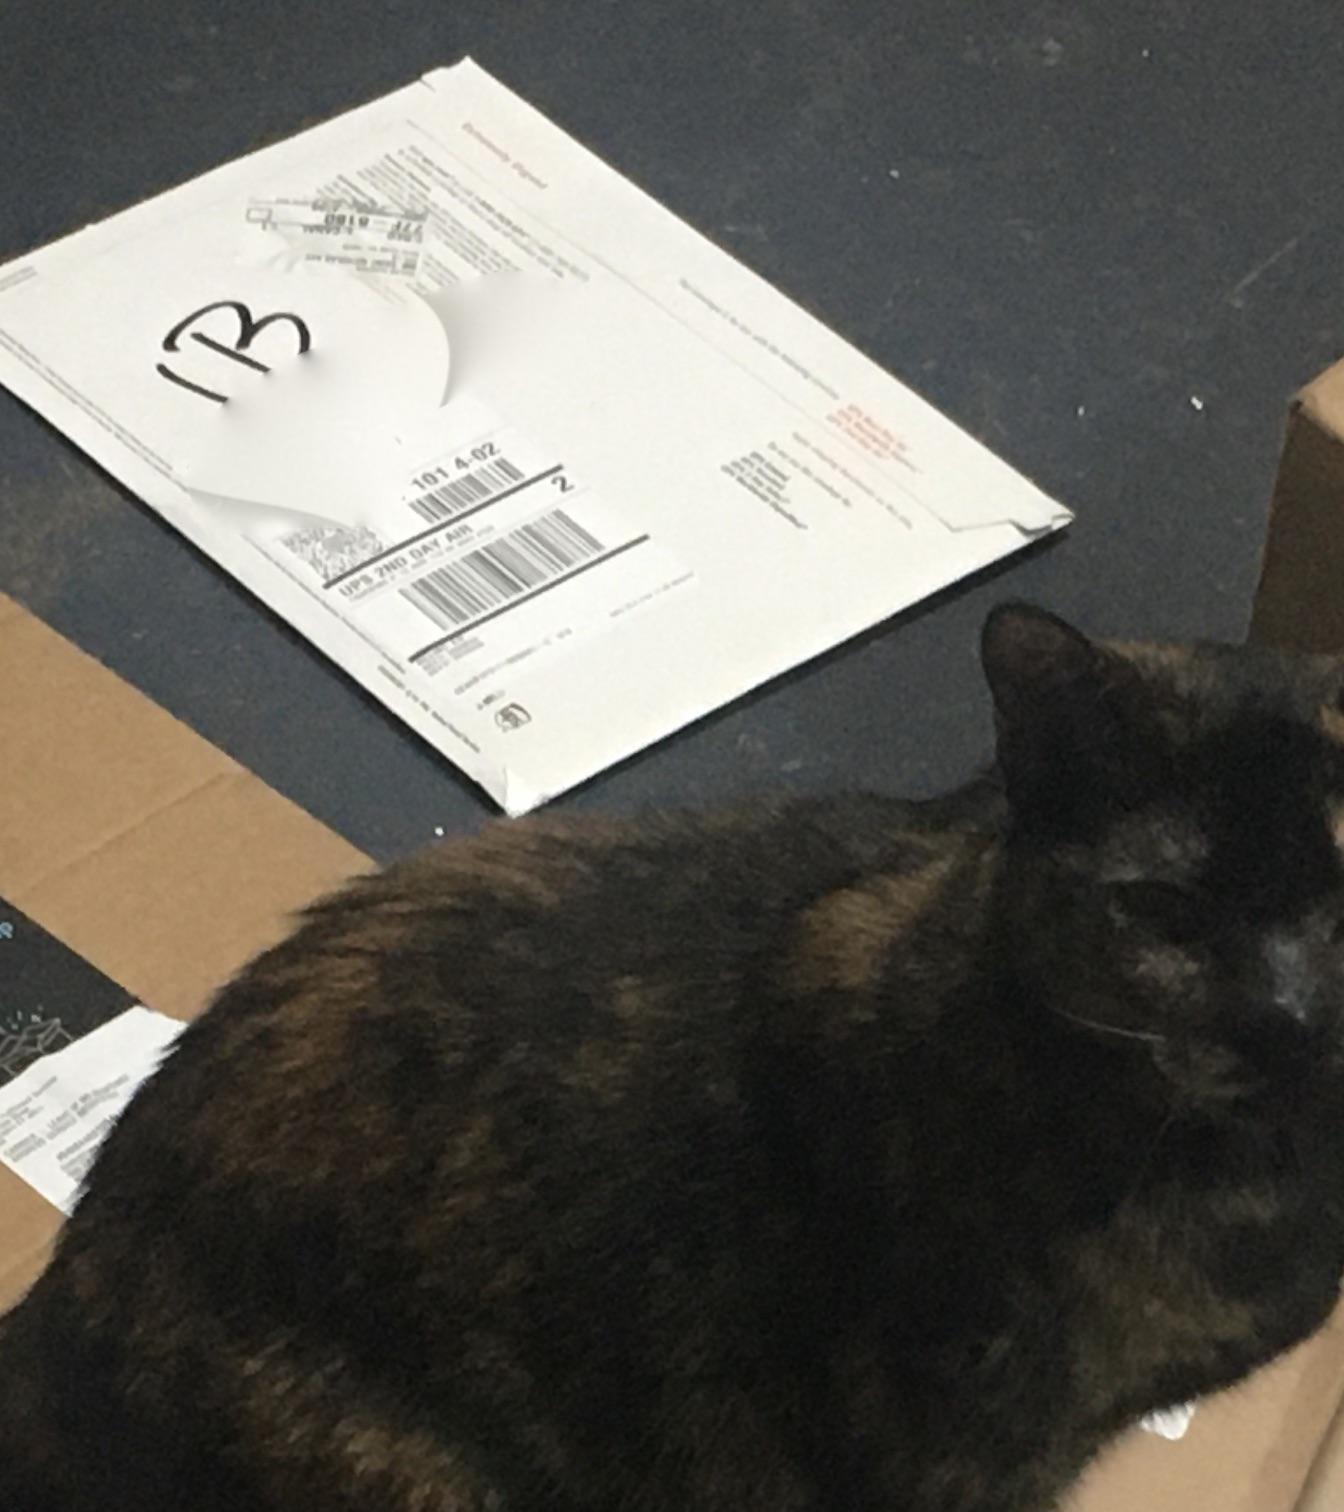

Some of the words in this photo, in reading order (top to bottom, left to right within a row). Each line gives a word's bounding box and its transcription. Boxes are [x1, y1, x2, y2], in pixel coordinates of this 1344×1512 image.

[411, 466, 450, 492] 101
[551, 475, 575, 493] 2
[338, 571, 374, 598] UPS
[374, 555, 408, 580] 2ND
[408, 541, 443, 564] DAY
[444, 523, 474, 544] AIR
